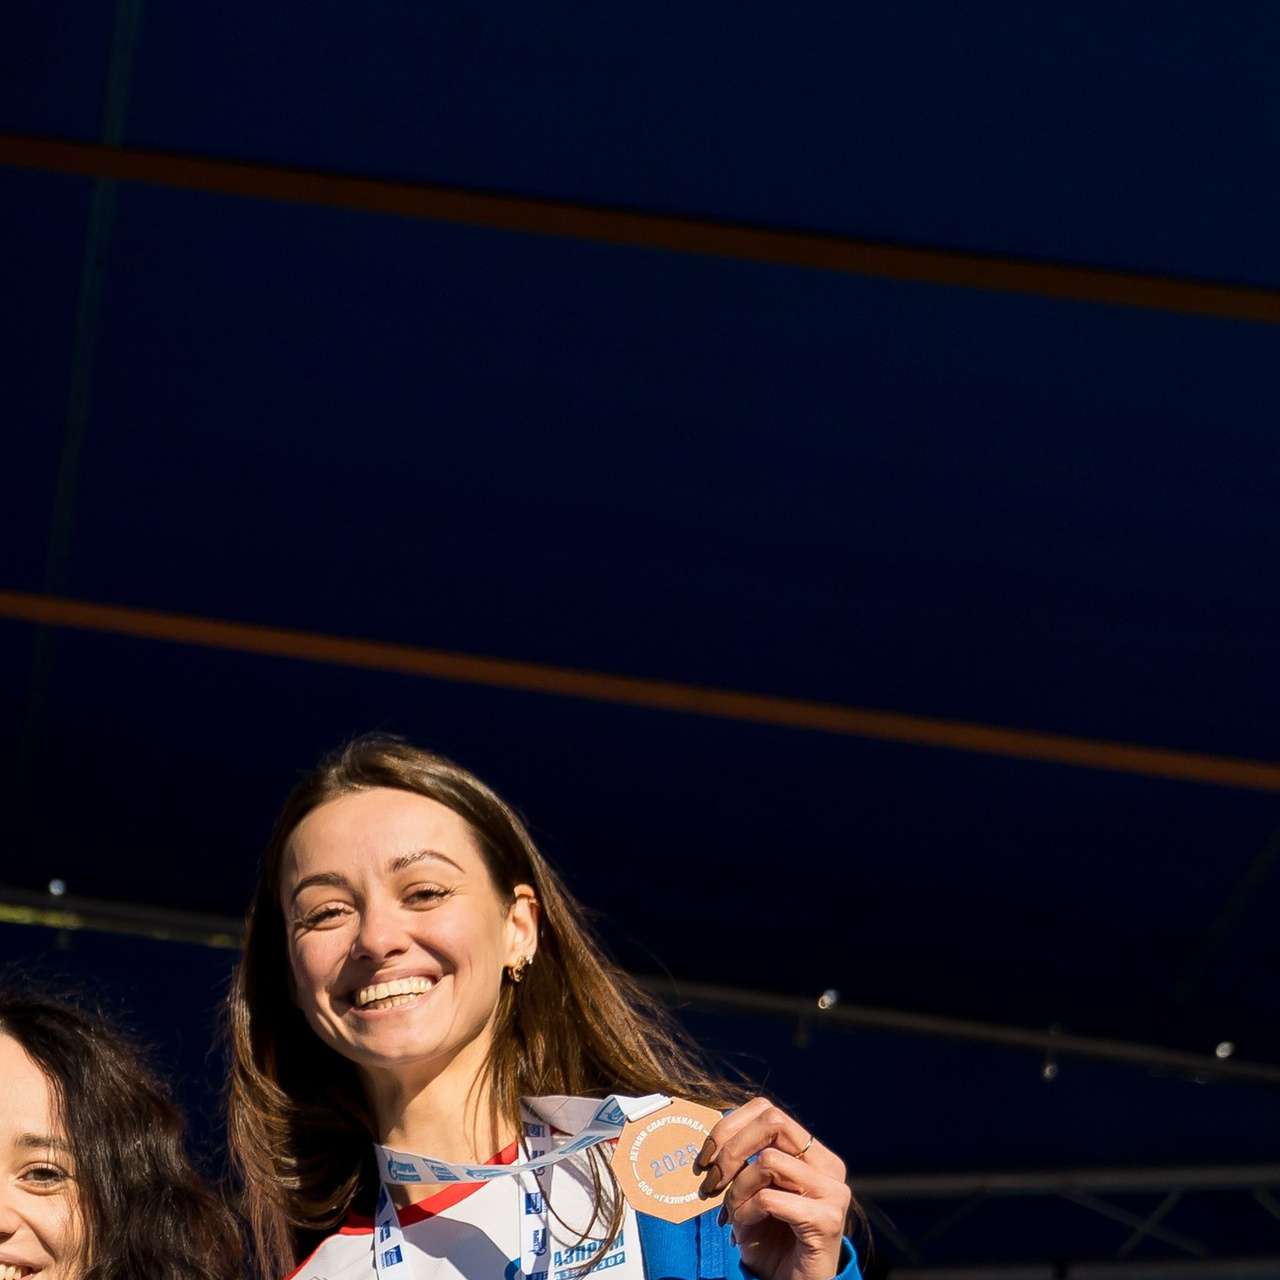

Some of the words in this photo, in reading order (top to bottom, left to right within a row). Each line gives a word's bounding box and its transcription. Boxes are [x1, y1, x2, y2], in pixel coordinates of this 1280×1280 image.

[629, 1129, 648, 1161] ЛЕТНЯЯ
[645, 1115, 705, 1133] СПАРТАКИАДА
[650, 1142, 701, 1179] 2025
[637, 1180, 653, 1196] ООО
